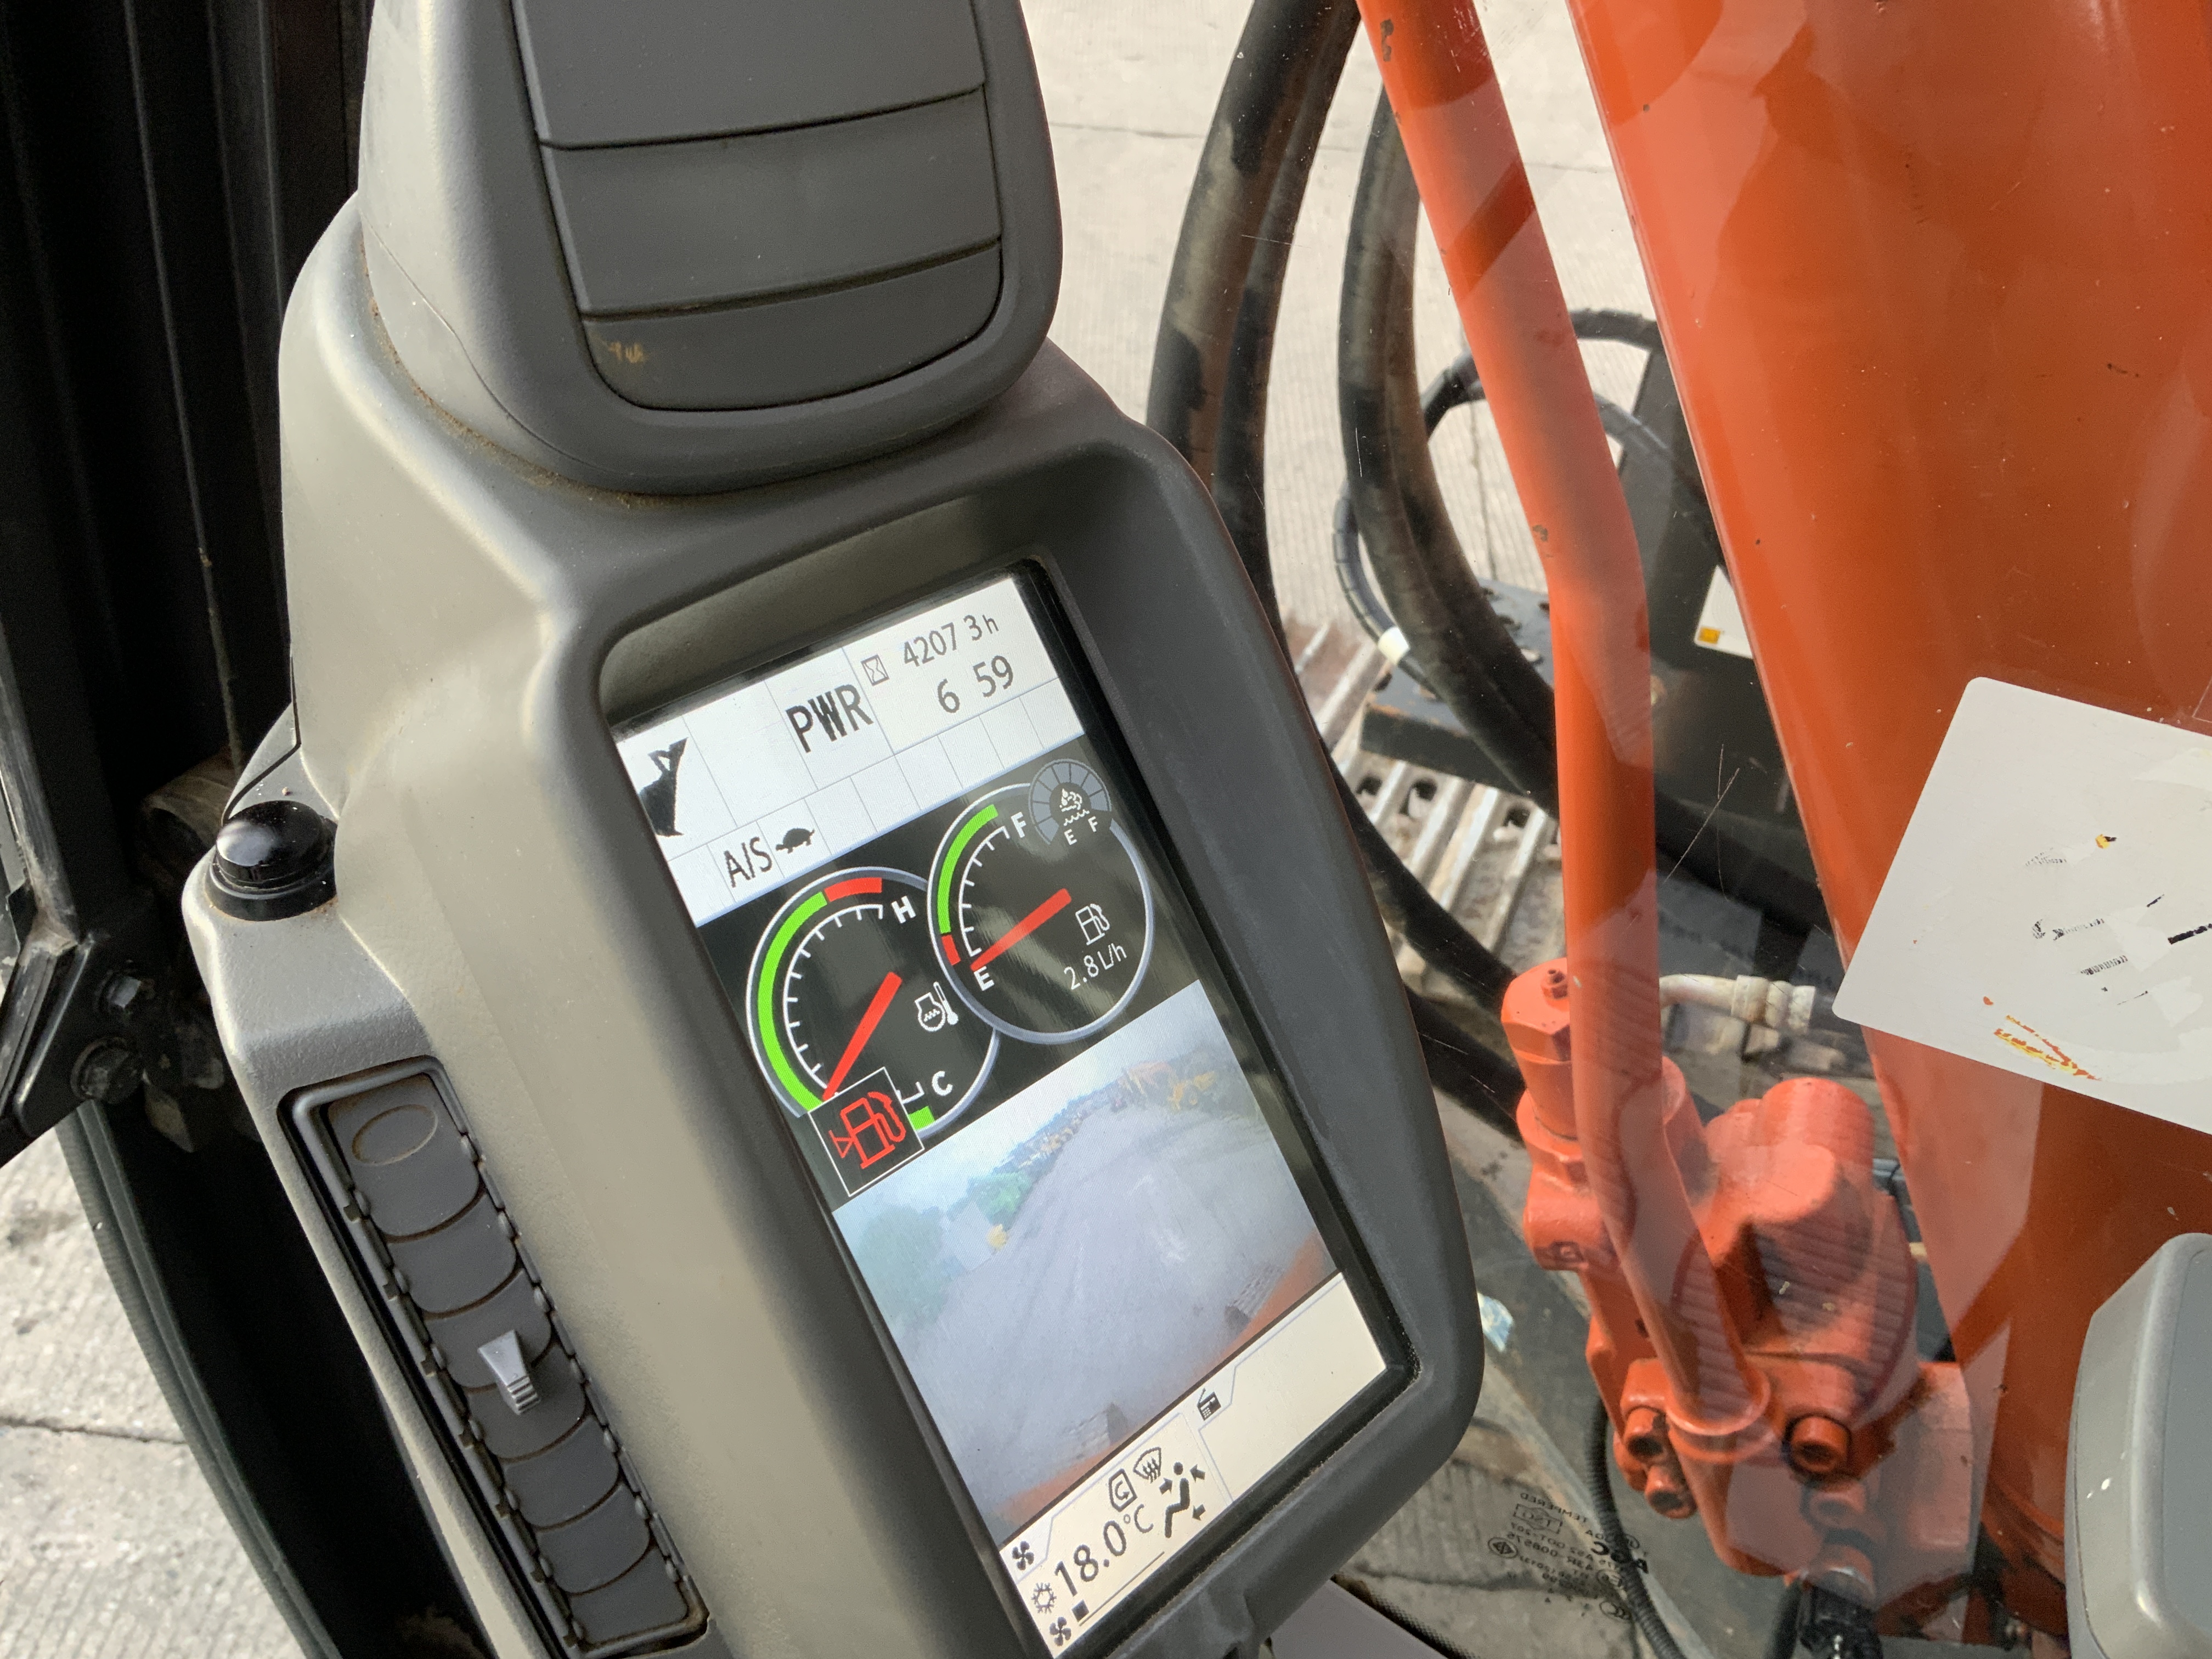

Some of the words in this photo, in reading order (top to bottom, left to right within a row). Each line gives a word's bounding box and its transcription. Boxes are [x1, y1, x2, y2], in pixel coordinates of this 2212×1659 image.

[786, 683, 874, 753] PWR
[1011, 811, 1027, 838] F
[1064, 829, 1077, 845] E
[1088, 816, 1098, 833] F
[724, 835, 771, 888] A/S
[891, 896, 917, 923] H
[974, 970, 995, 991] E
[932, 1071, 953, 1097] C
